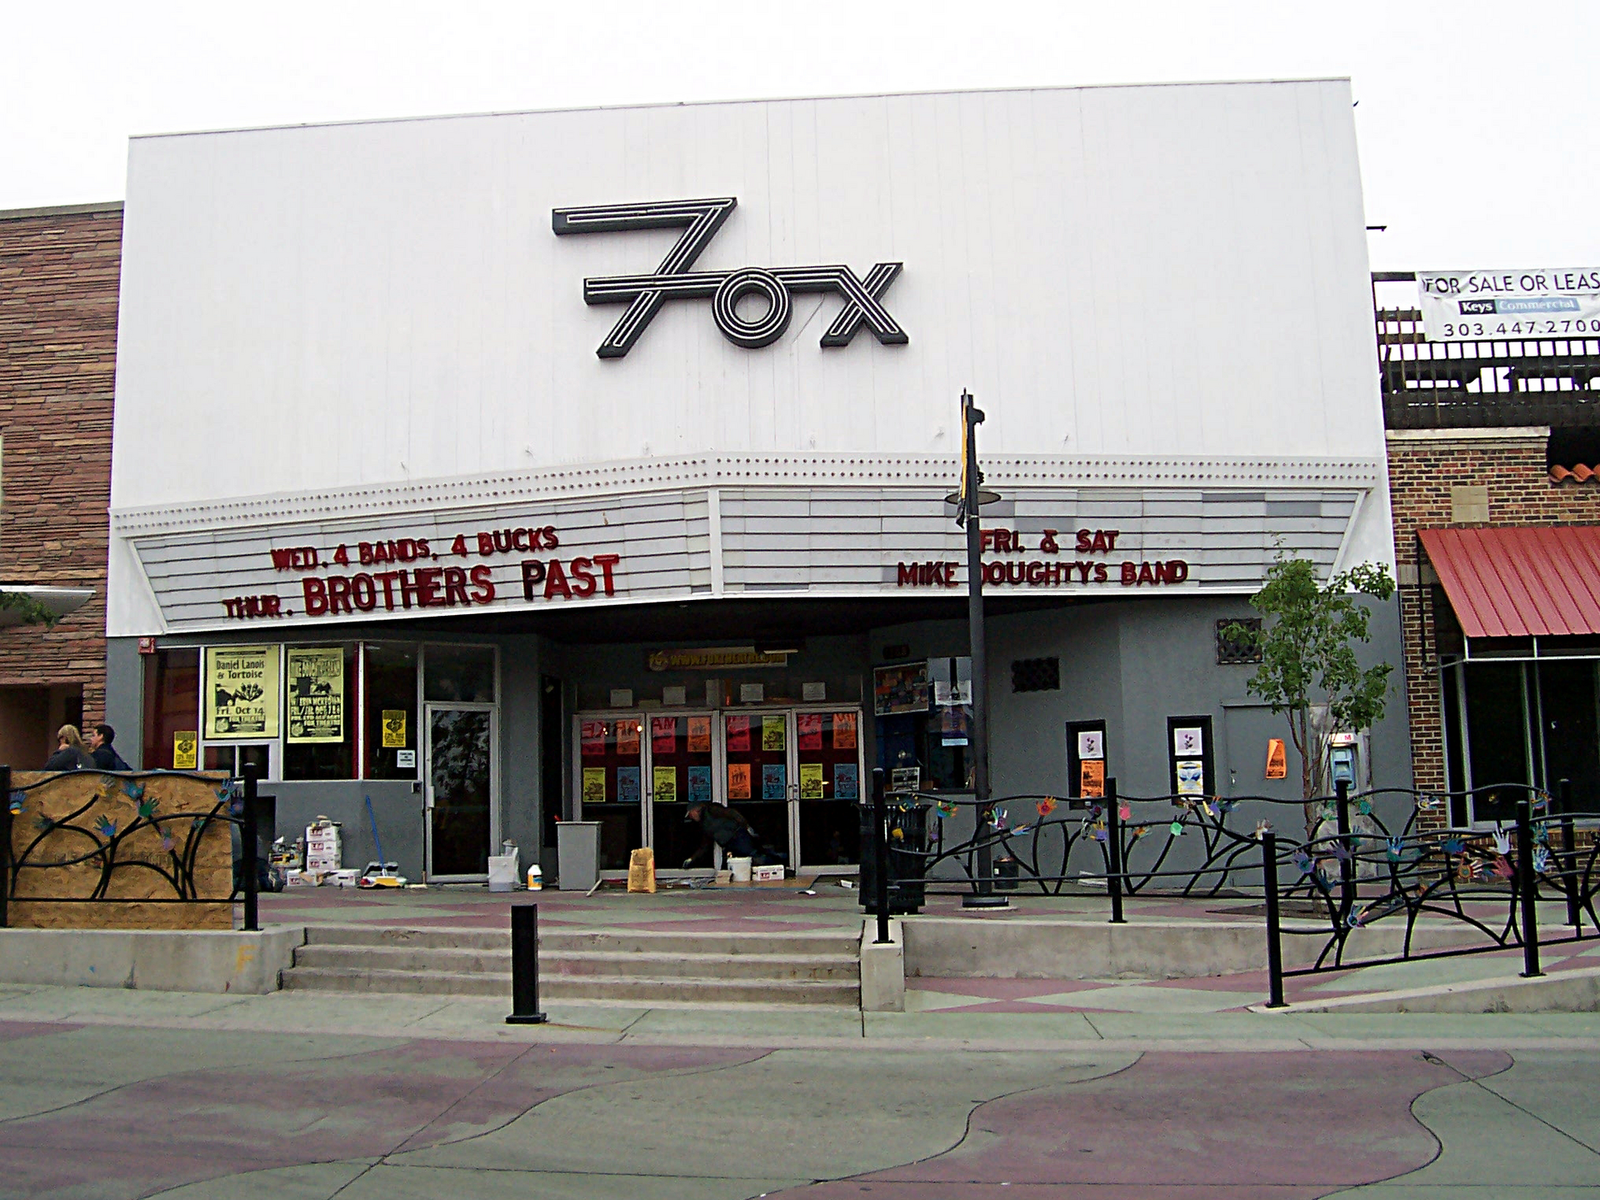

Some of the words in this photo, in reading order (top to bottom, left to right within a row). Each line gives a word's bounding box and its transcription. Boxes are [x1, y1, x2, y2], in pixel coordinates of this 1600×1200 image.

[1423, 278, 1461, 294] FOR
[1469, 276, 1514, 292] SALE
[1520, 274, 1548, 292] OR
[1461, 301, 1493, 314] Keys
[1499, 299, 1575, 310] Commercial
[1444, 319, 1600, 337] 303.447.2700
[270, 546, 328, 572] WED.
[333, 543, 349, 567] 4
[451, 533, 468, 558] 4
[477, 525, 559, 556] BUCKS
[980, 528, 1026, 554] FRI.
[1040, 529, 1059, 554] &
[1075, 528, 1119, 554] SAT
[897, 561, 960, 587] MIKE
[1121, 560, 1188, 586] BAND
[222, 594, 293, 619] THUR.
[302, 564, 496, 616] BROTHERS
[521, 554, 620, 601] PAST
[216, 660, 239, 670] Daniel
[242, 660, 264, 669] Lanois
[228, 670, 263, 679] Tortoise
[236, 706, 251, 714] Oct
[254, 707, 264, 715] 14
